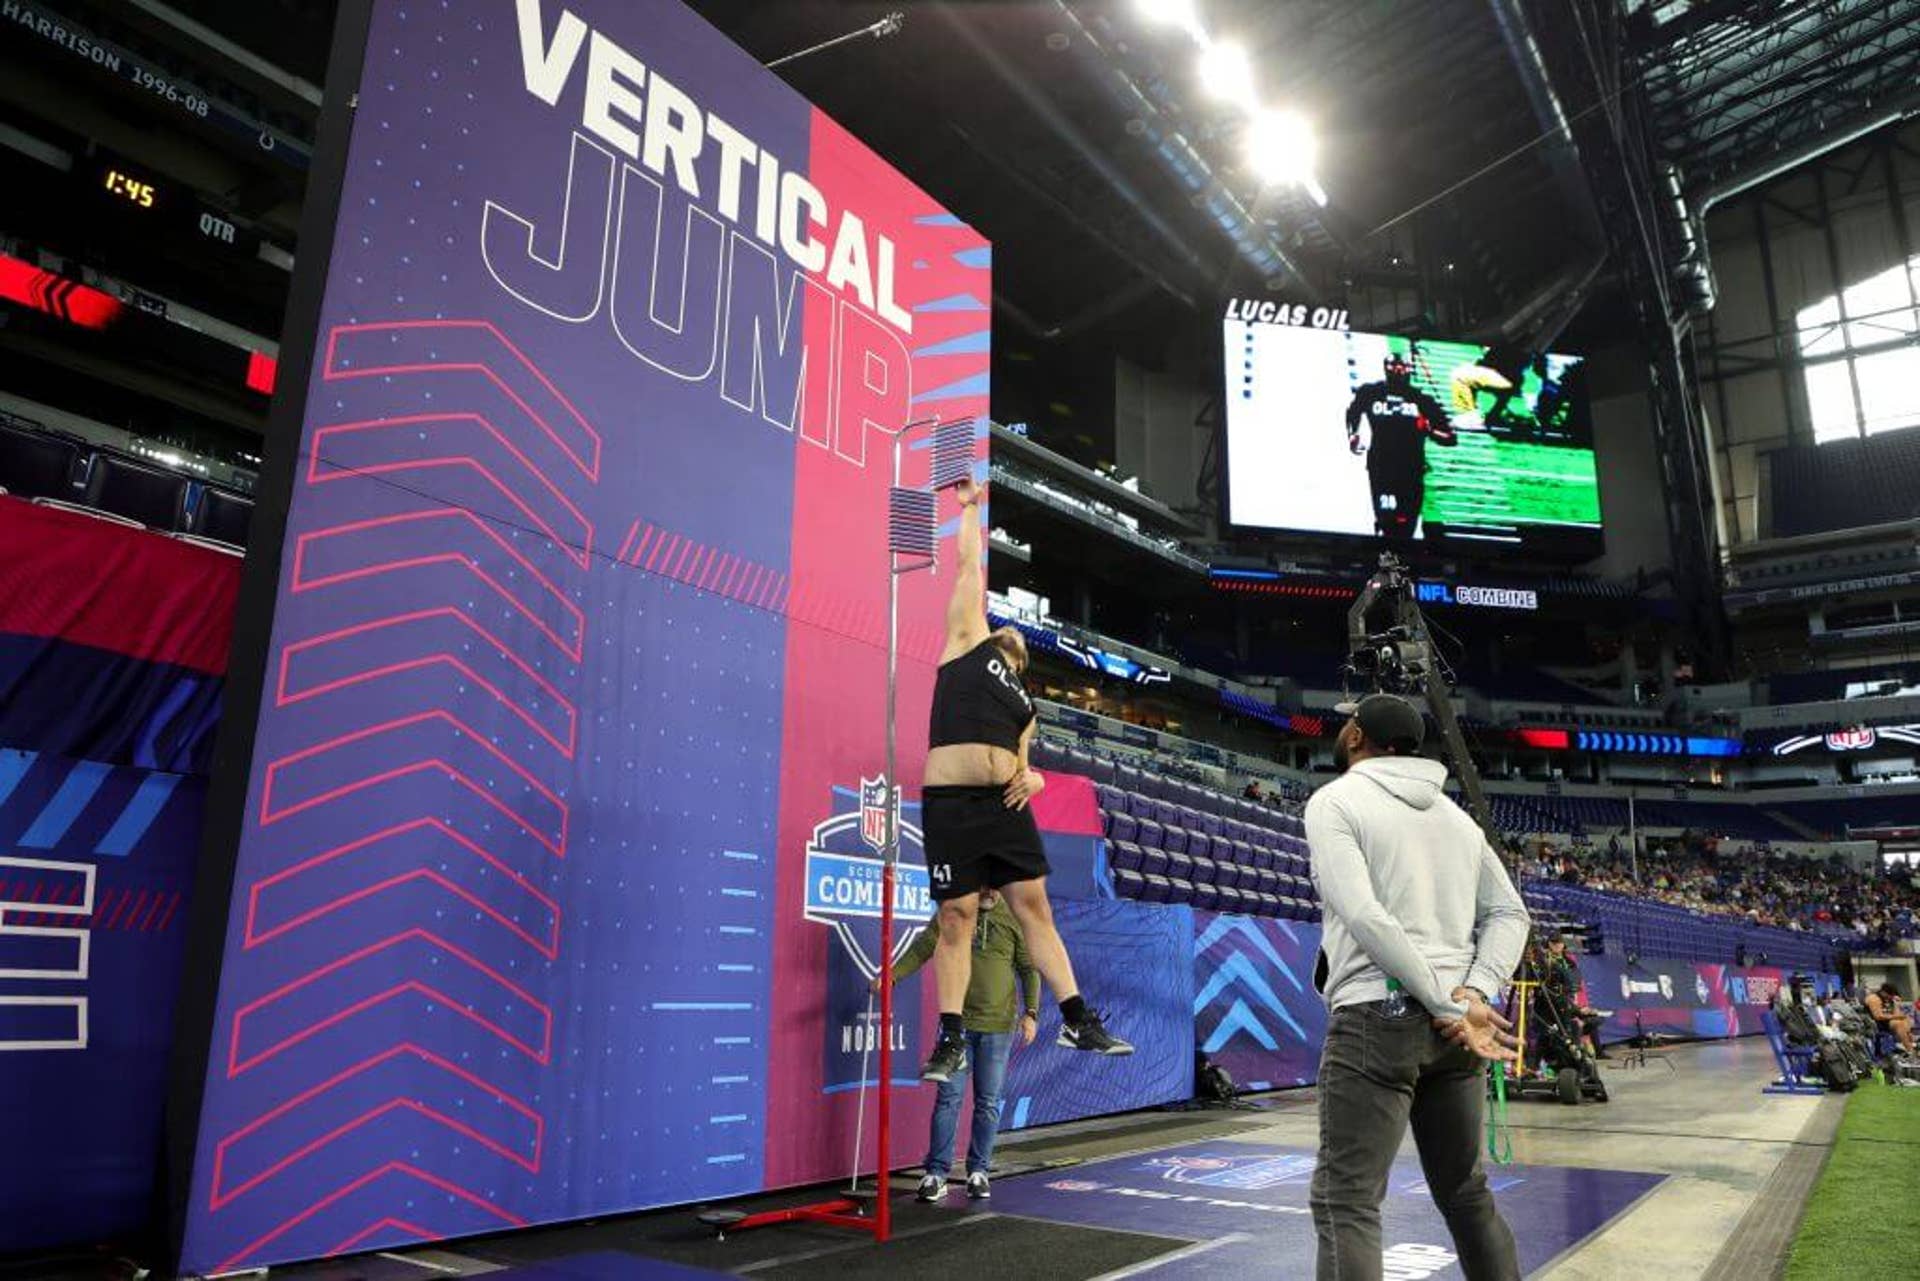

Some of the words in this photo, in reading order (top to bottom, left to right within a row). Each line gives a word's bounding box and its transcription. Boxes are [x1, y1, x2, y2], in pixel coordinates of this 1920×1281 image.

[2, 1, 121, 72] HARRISON
[131, 66, 209, 117] 1996-08
[516, 0, 912, 334] VERTICAL
[105, 170, 155, 208] 1:45
[199, 213, 235, 243] QTR
[481, 131, 912, 468] JUMP
[1225, 298, 1308, 326] LUCAS
[1312, 307, 1350, 331] OIL
[1418, 583, 1453, 603] NFL
[1456, 586, 1538, 609] COMBINE
[932, 864, 952, 882] 41
